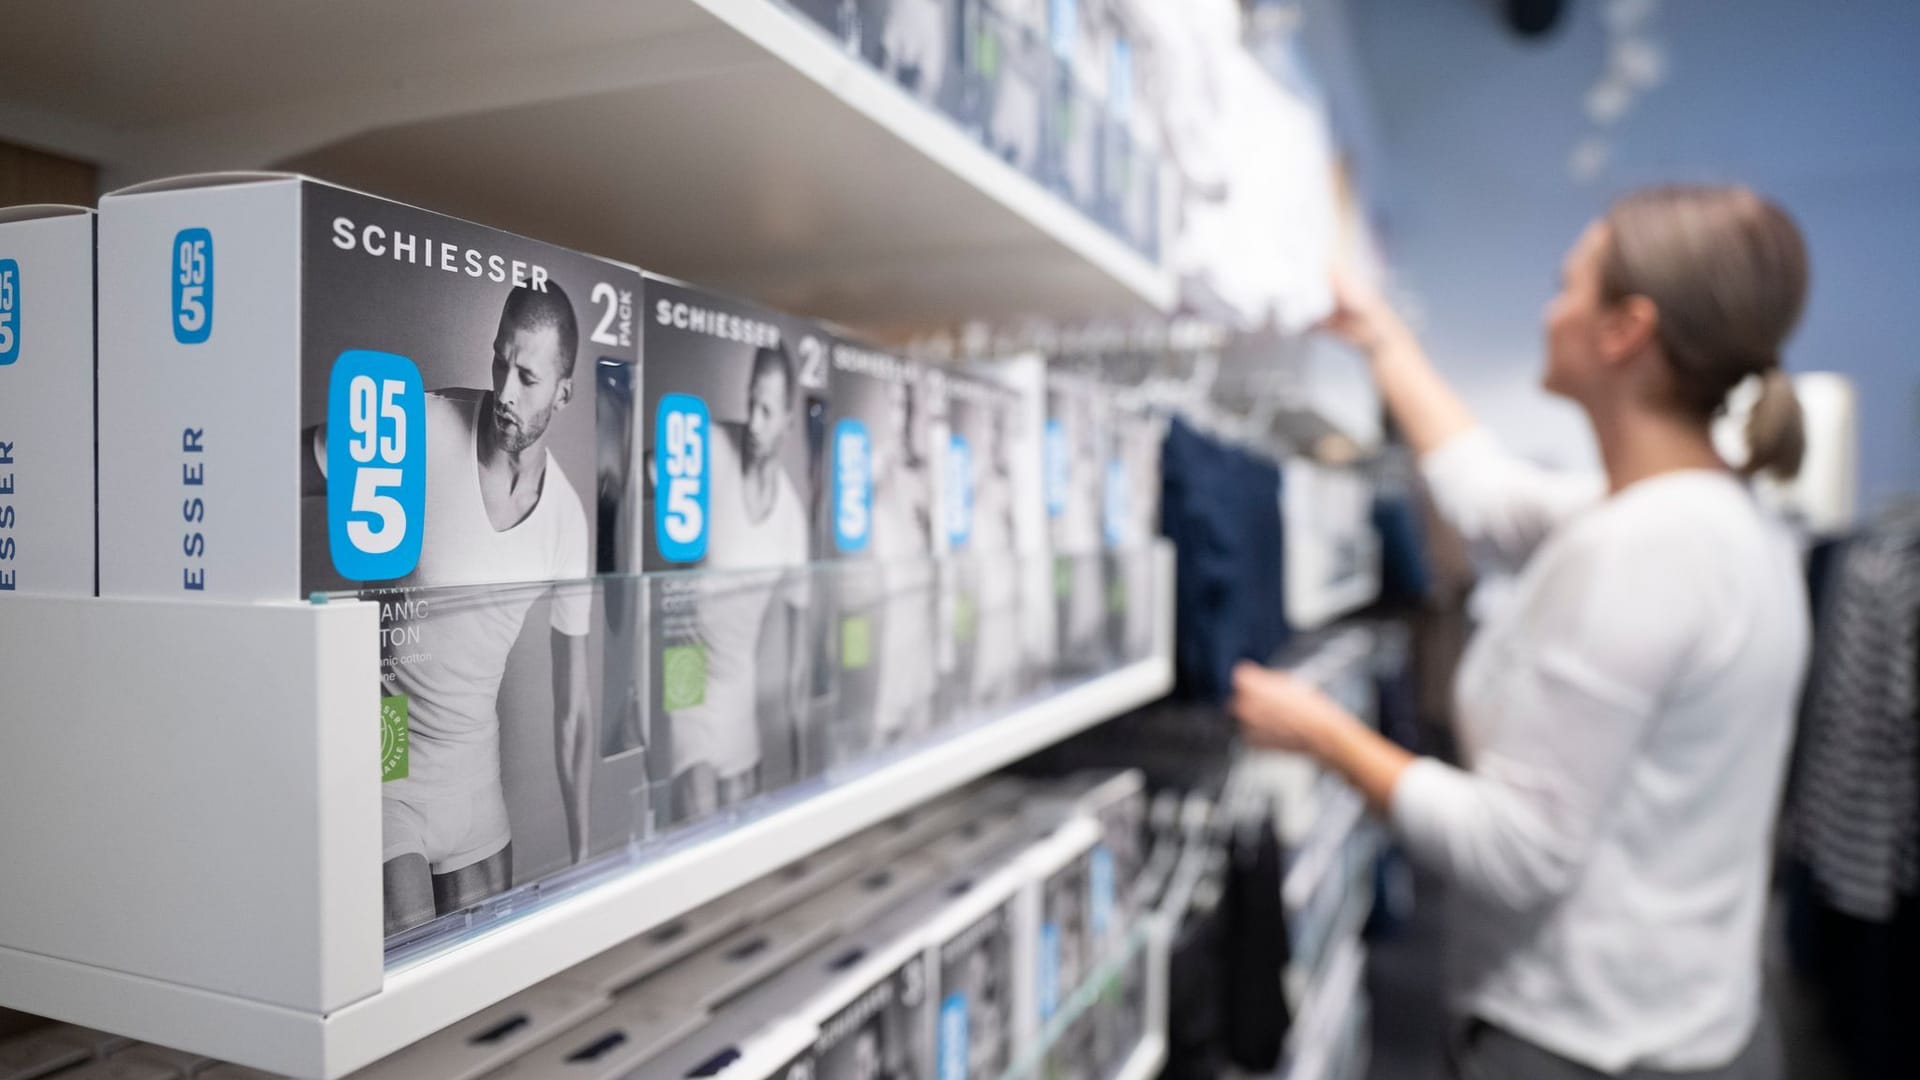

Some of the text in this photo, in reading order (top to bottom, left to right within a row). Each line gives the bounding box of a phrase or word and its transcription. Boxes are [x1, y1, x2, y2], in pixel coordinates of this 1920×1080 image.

[179, 240, 206, 285] 95
[332, 217, 549, 293] SCHIESSER
[0, 271, 13, 311] 5
[179, 286, 206, 331] 5
[590, 282, 618, 347] 2
[619, 289, 632, 347] PACK
[799, 336, 822, 388] 2
[349, 375, 407, 464] 95
[665, 410, 702, 477] 95
[346, 467, 407, 554] 5
[664, 477, 703, 543] 5
[400, 653, 432, 665] cotton
